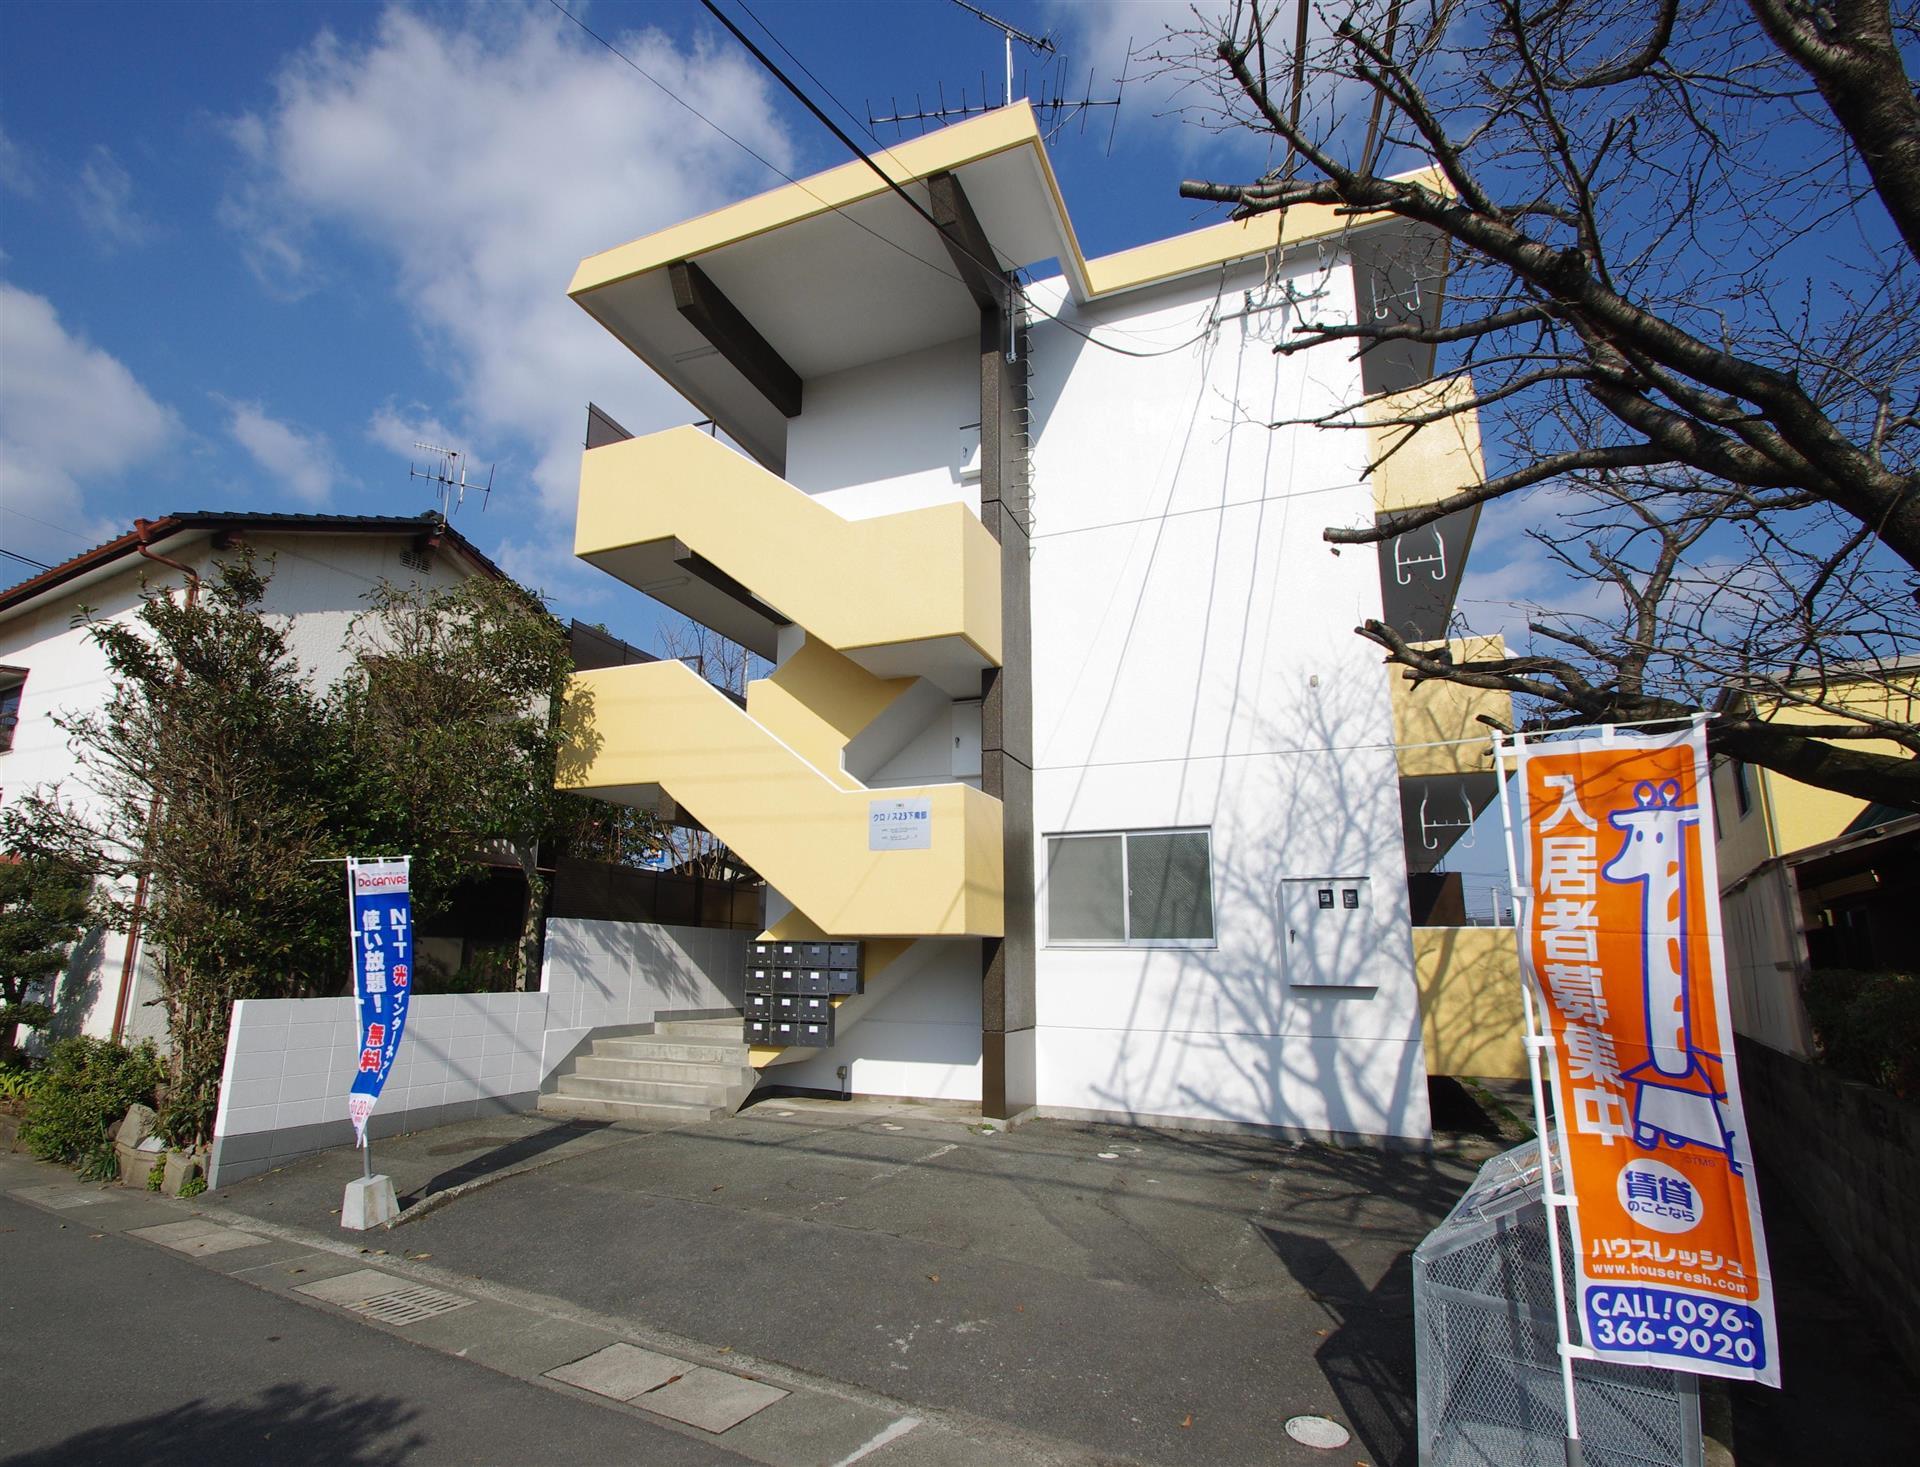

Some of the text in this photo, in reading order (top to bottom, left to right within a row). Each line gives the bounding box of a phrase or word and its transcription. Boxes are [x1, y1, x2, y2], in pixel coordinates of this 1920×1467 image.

[1539, 774, 1634, 1146] 入居者募集中
[360, 1022, 385, 1073] 無料
[1625, 1170, 1693, 1210] 賃貸
[1628, 1200, 1695, 1222] のことなら
[1592, 1238, 1747, 1278] ハウスレッシュ
[1592, 1262, 1749, 1295] www.houseresh.com
[1598, 1319, 1757, 1362] 366-9020
